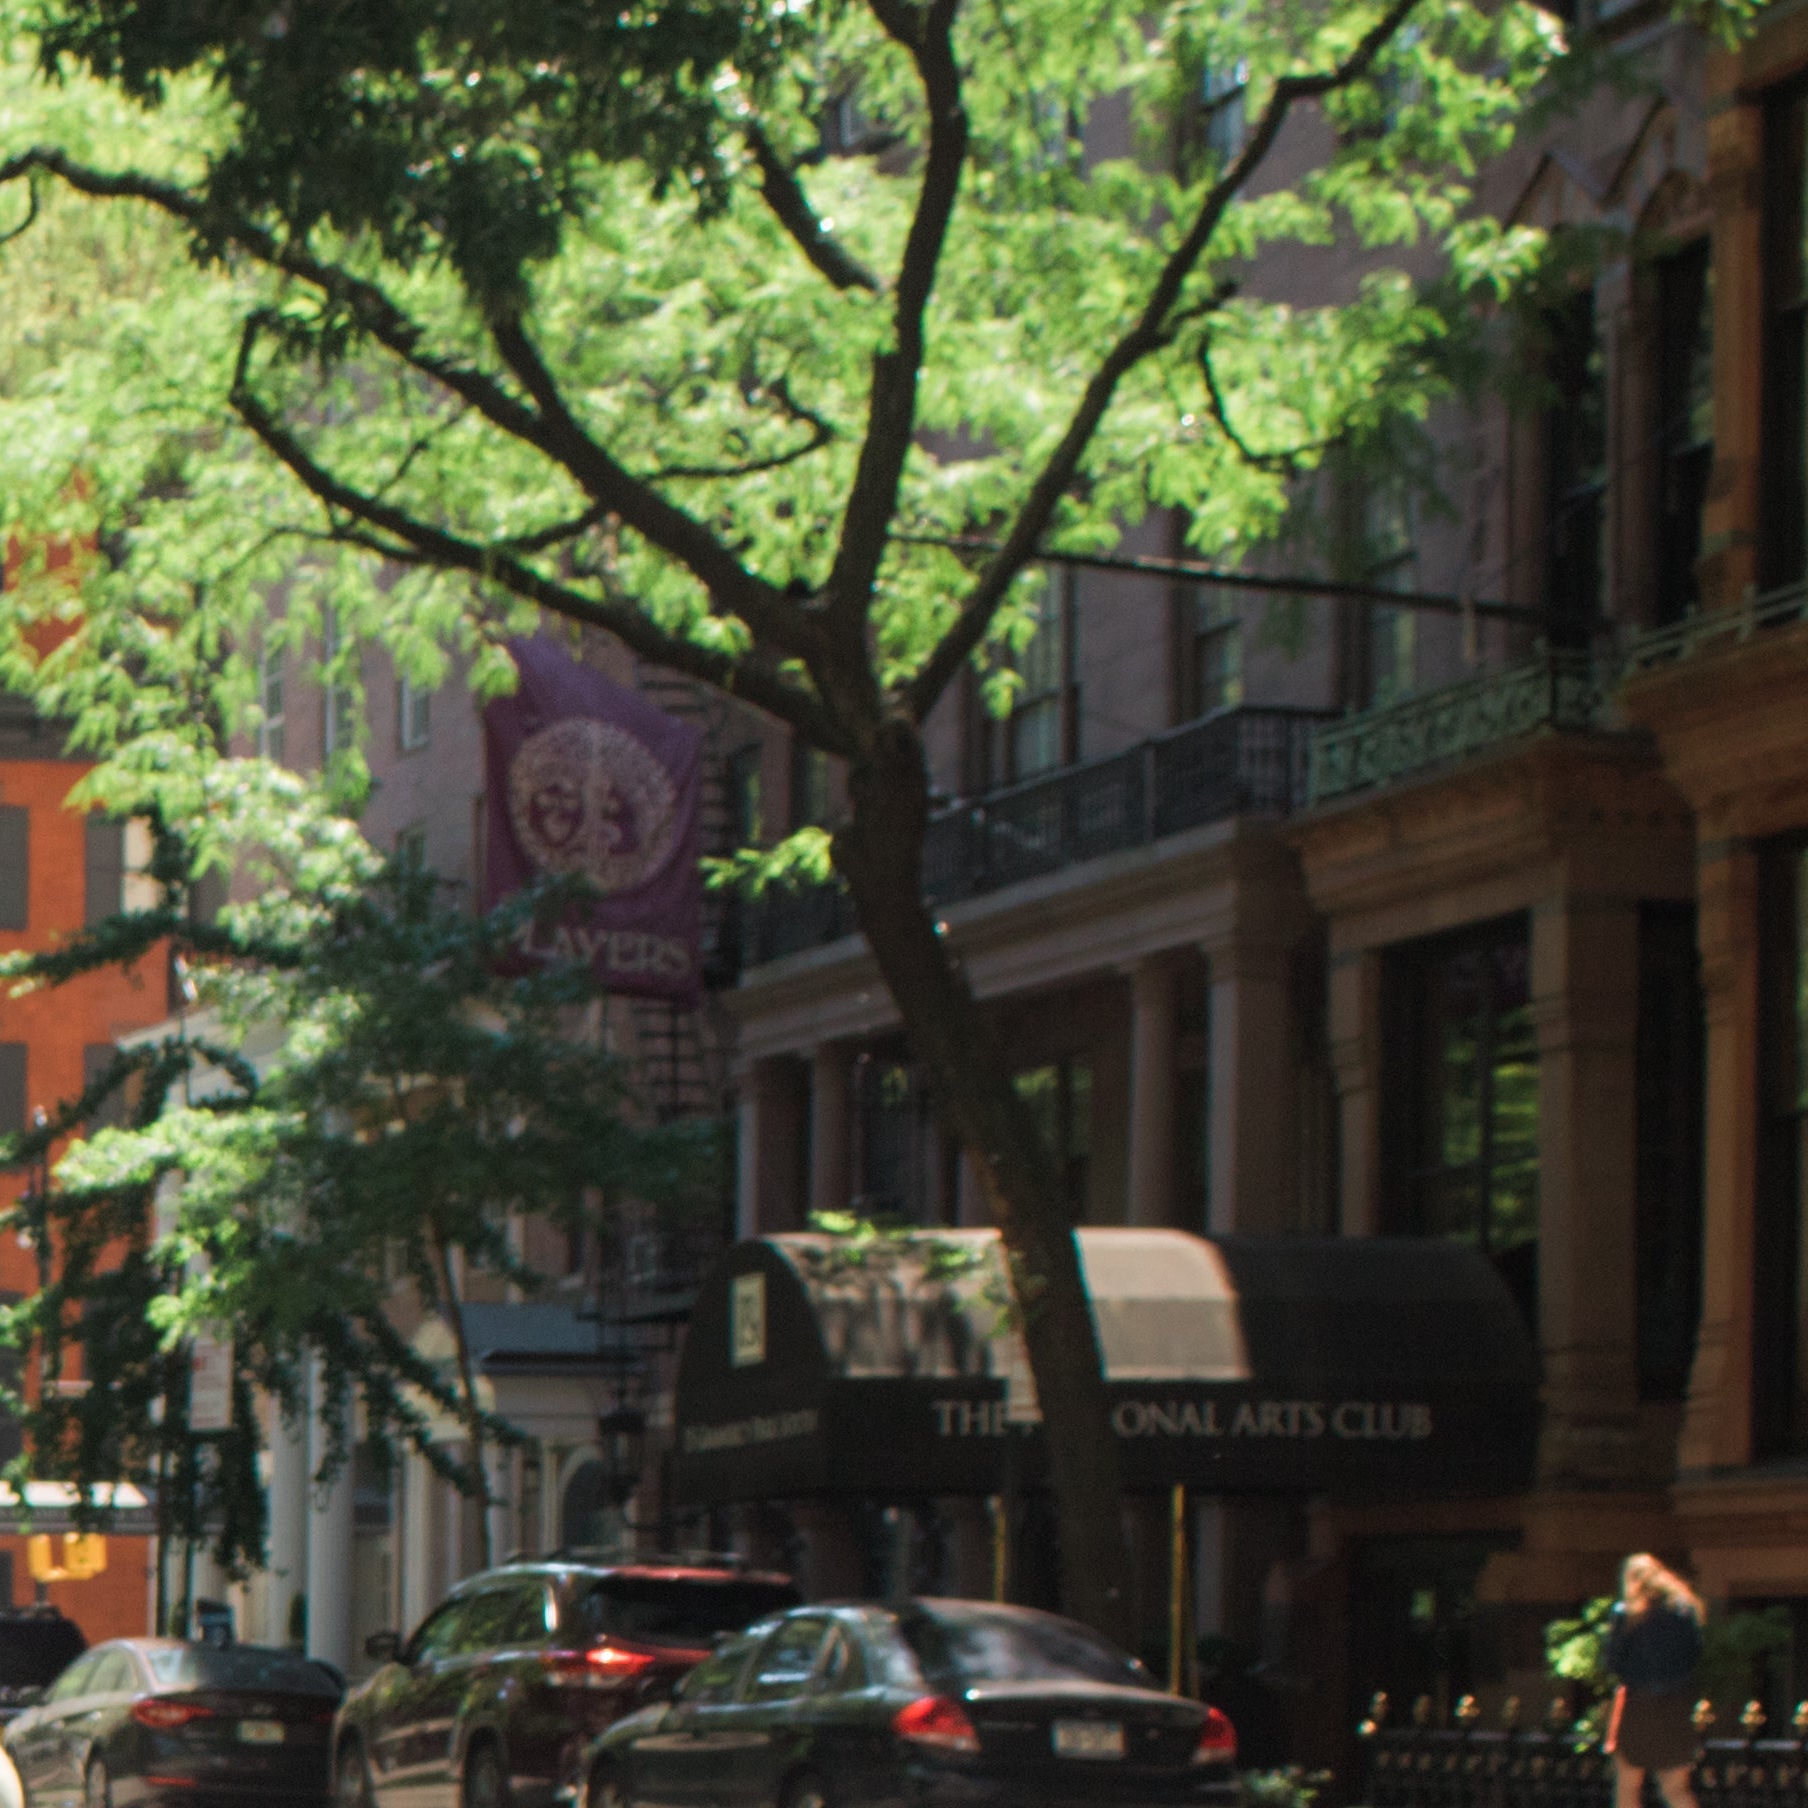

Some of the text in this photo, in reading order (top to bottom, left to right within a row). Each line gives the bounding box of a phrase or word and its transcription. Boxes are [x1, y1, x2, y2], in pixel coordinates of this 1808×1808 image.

[931, 1399, 1008, 1437] THE
[1231, 1400, 1326, 1437] ARTS
[1330, 1401, 1433, 1439] CLUB
